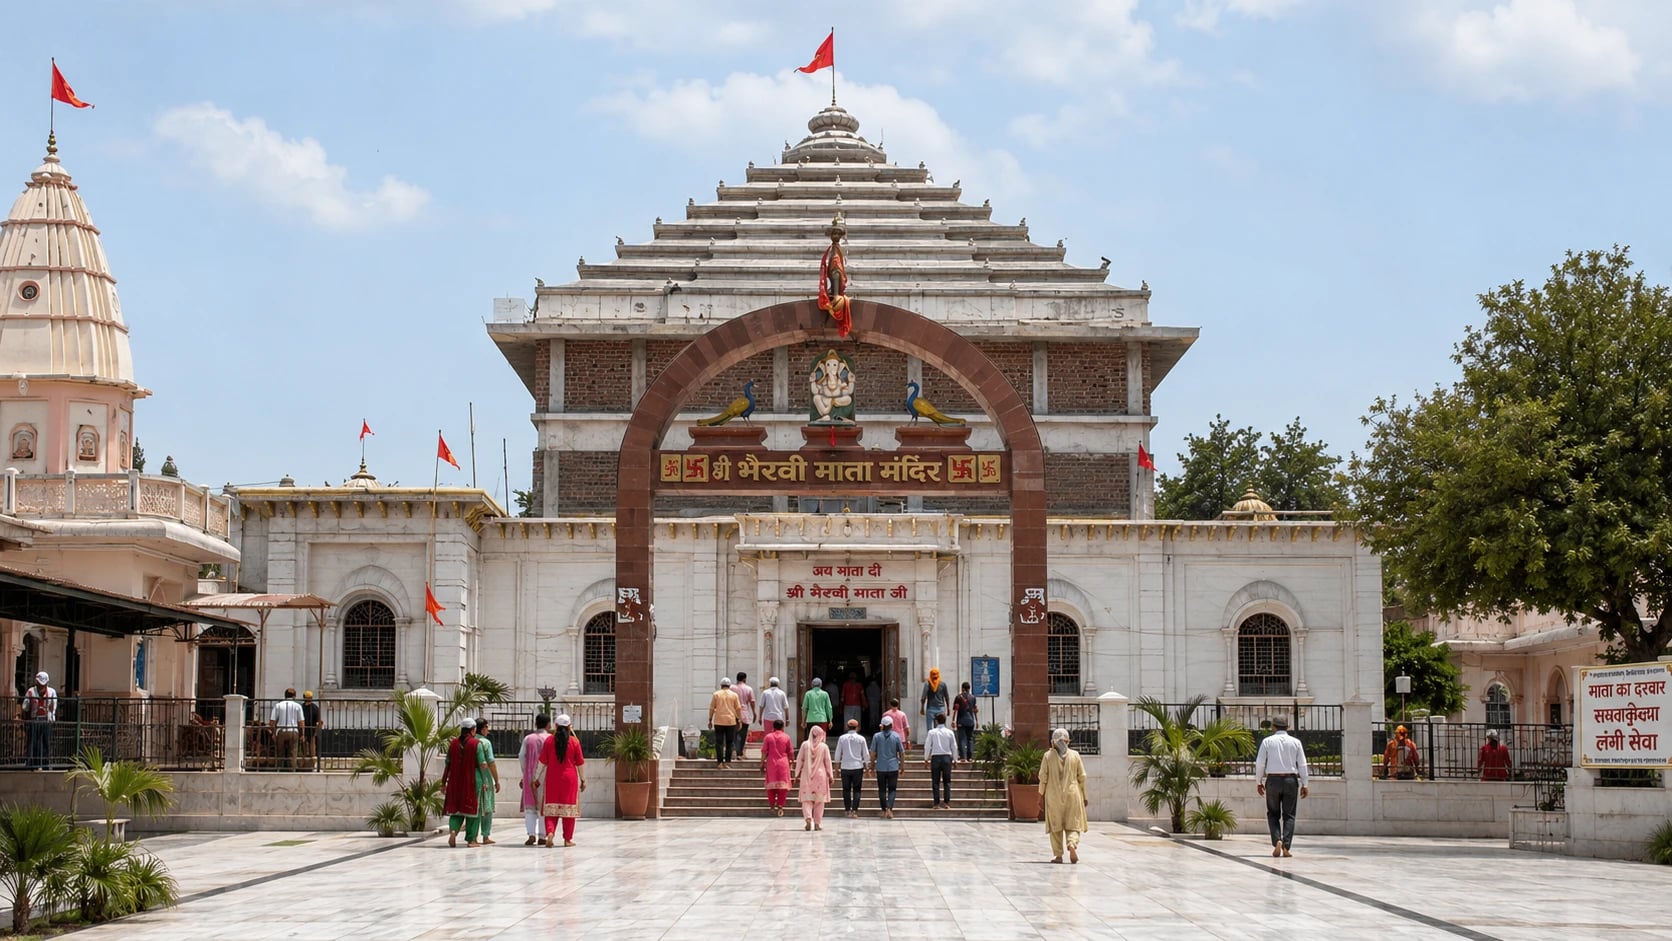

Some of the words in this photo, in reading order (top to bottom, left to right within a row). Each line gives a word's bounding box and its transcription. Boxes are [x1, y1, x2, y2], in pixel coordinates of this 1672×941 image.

[737, 453, 808, 481] भैरवी
[813, 461, 874, 481] माता
[879, 454, 943, 482] मंदिर
[868, 562, 882, 577] दी
[853, 588, 885, 598] माता
[890, 585, 908, 598] जी
[1588, 684, 1613, 698] माता
[1616, 683, 1631, 696] का
[1628, 728, 1658, 750] सेवा
